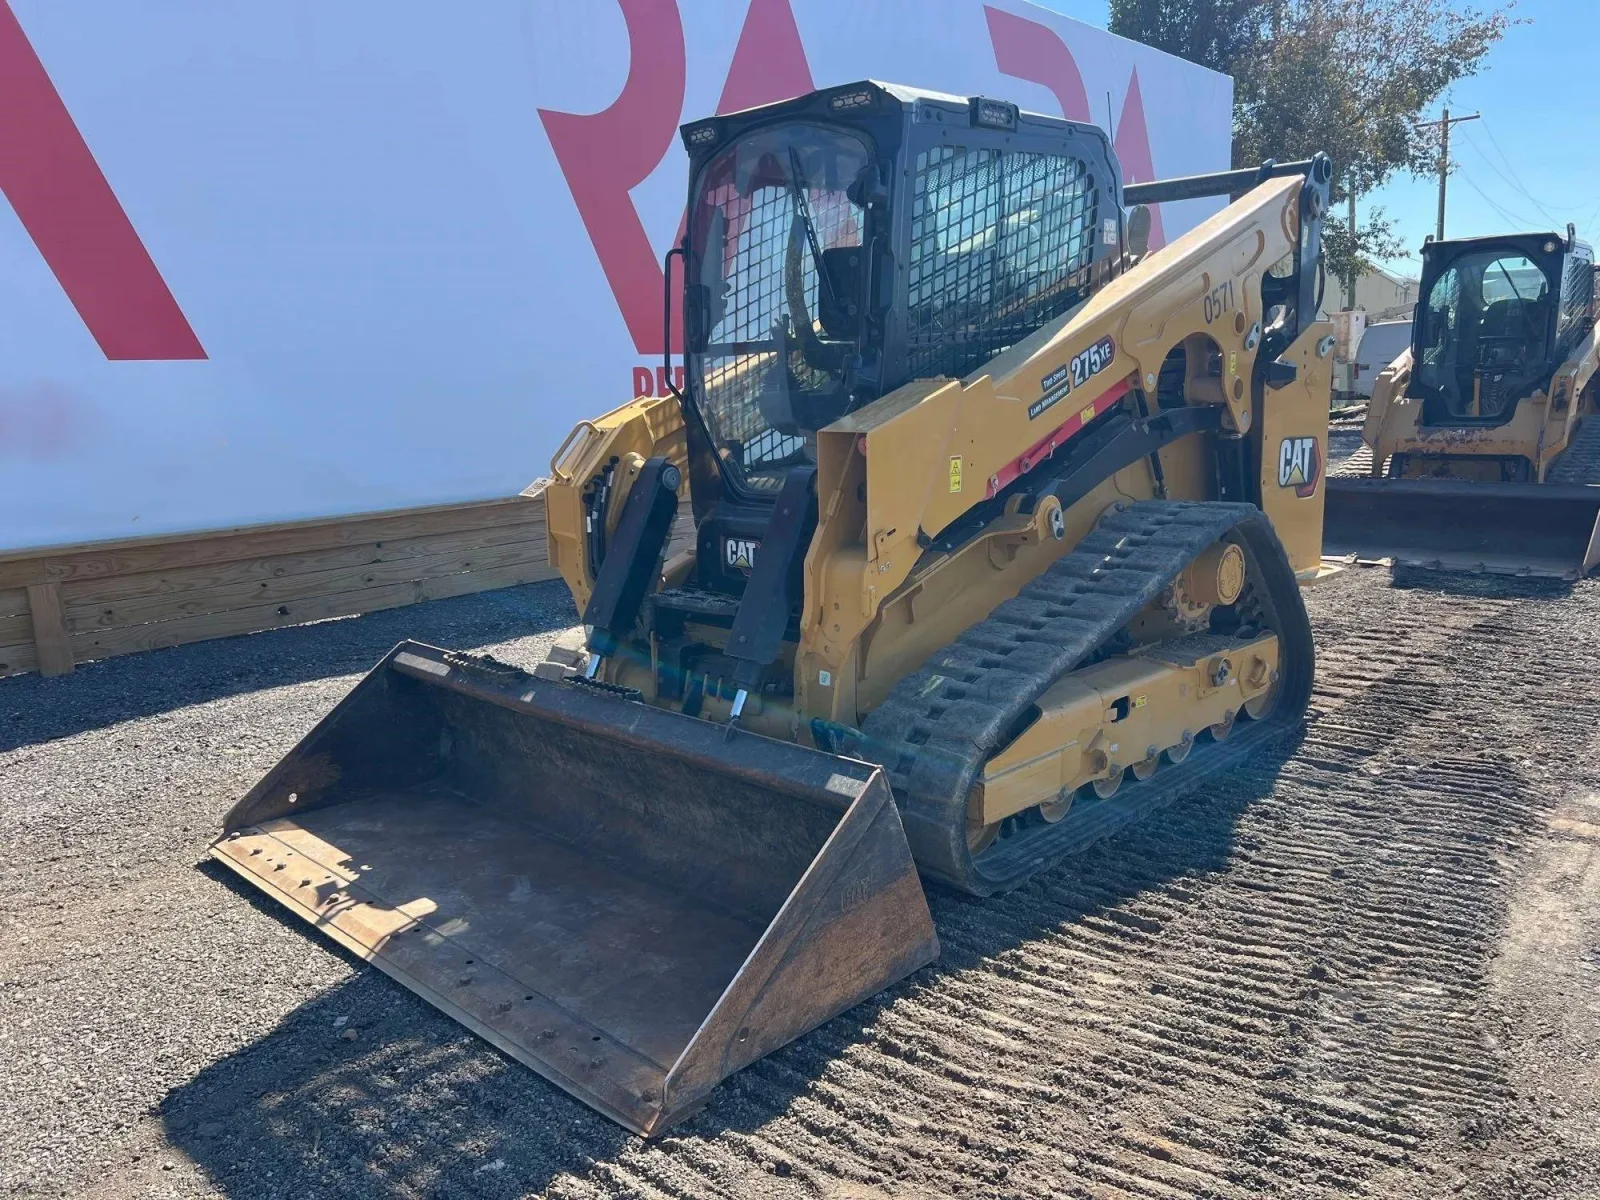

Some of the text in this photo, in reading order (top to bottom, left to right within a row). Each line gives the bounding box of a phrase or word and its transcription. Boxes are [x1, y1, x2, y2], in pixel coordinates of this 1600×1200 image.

[1204, 279, 1234, 324] 0571
[1280, 438, 1313, 486] CAT
[726, 539, 756, 568] CAT
